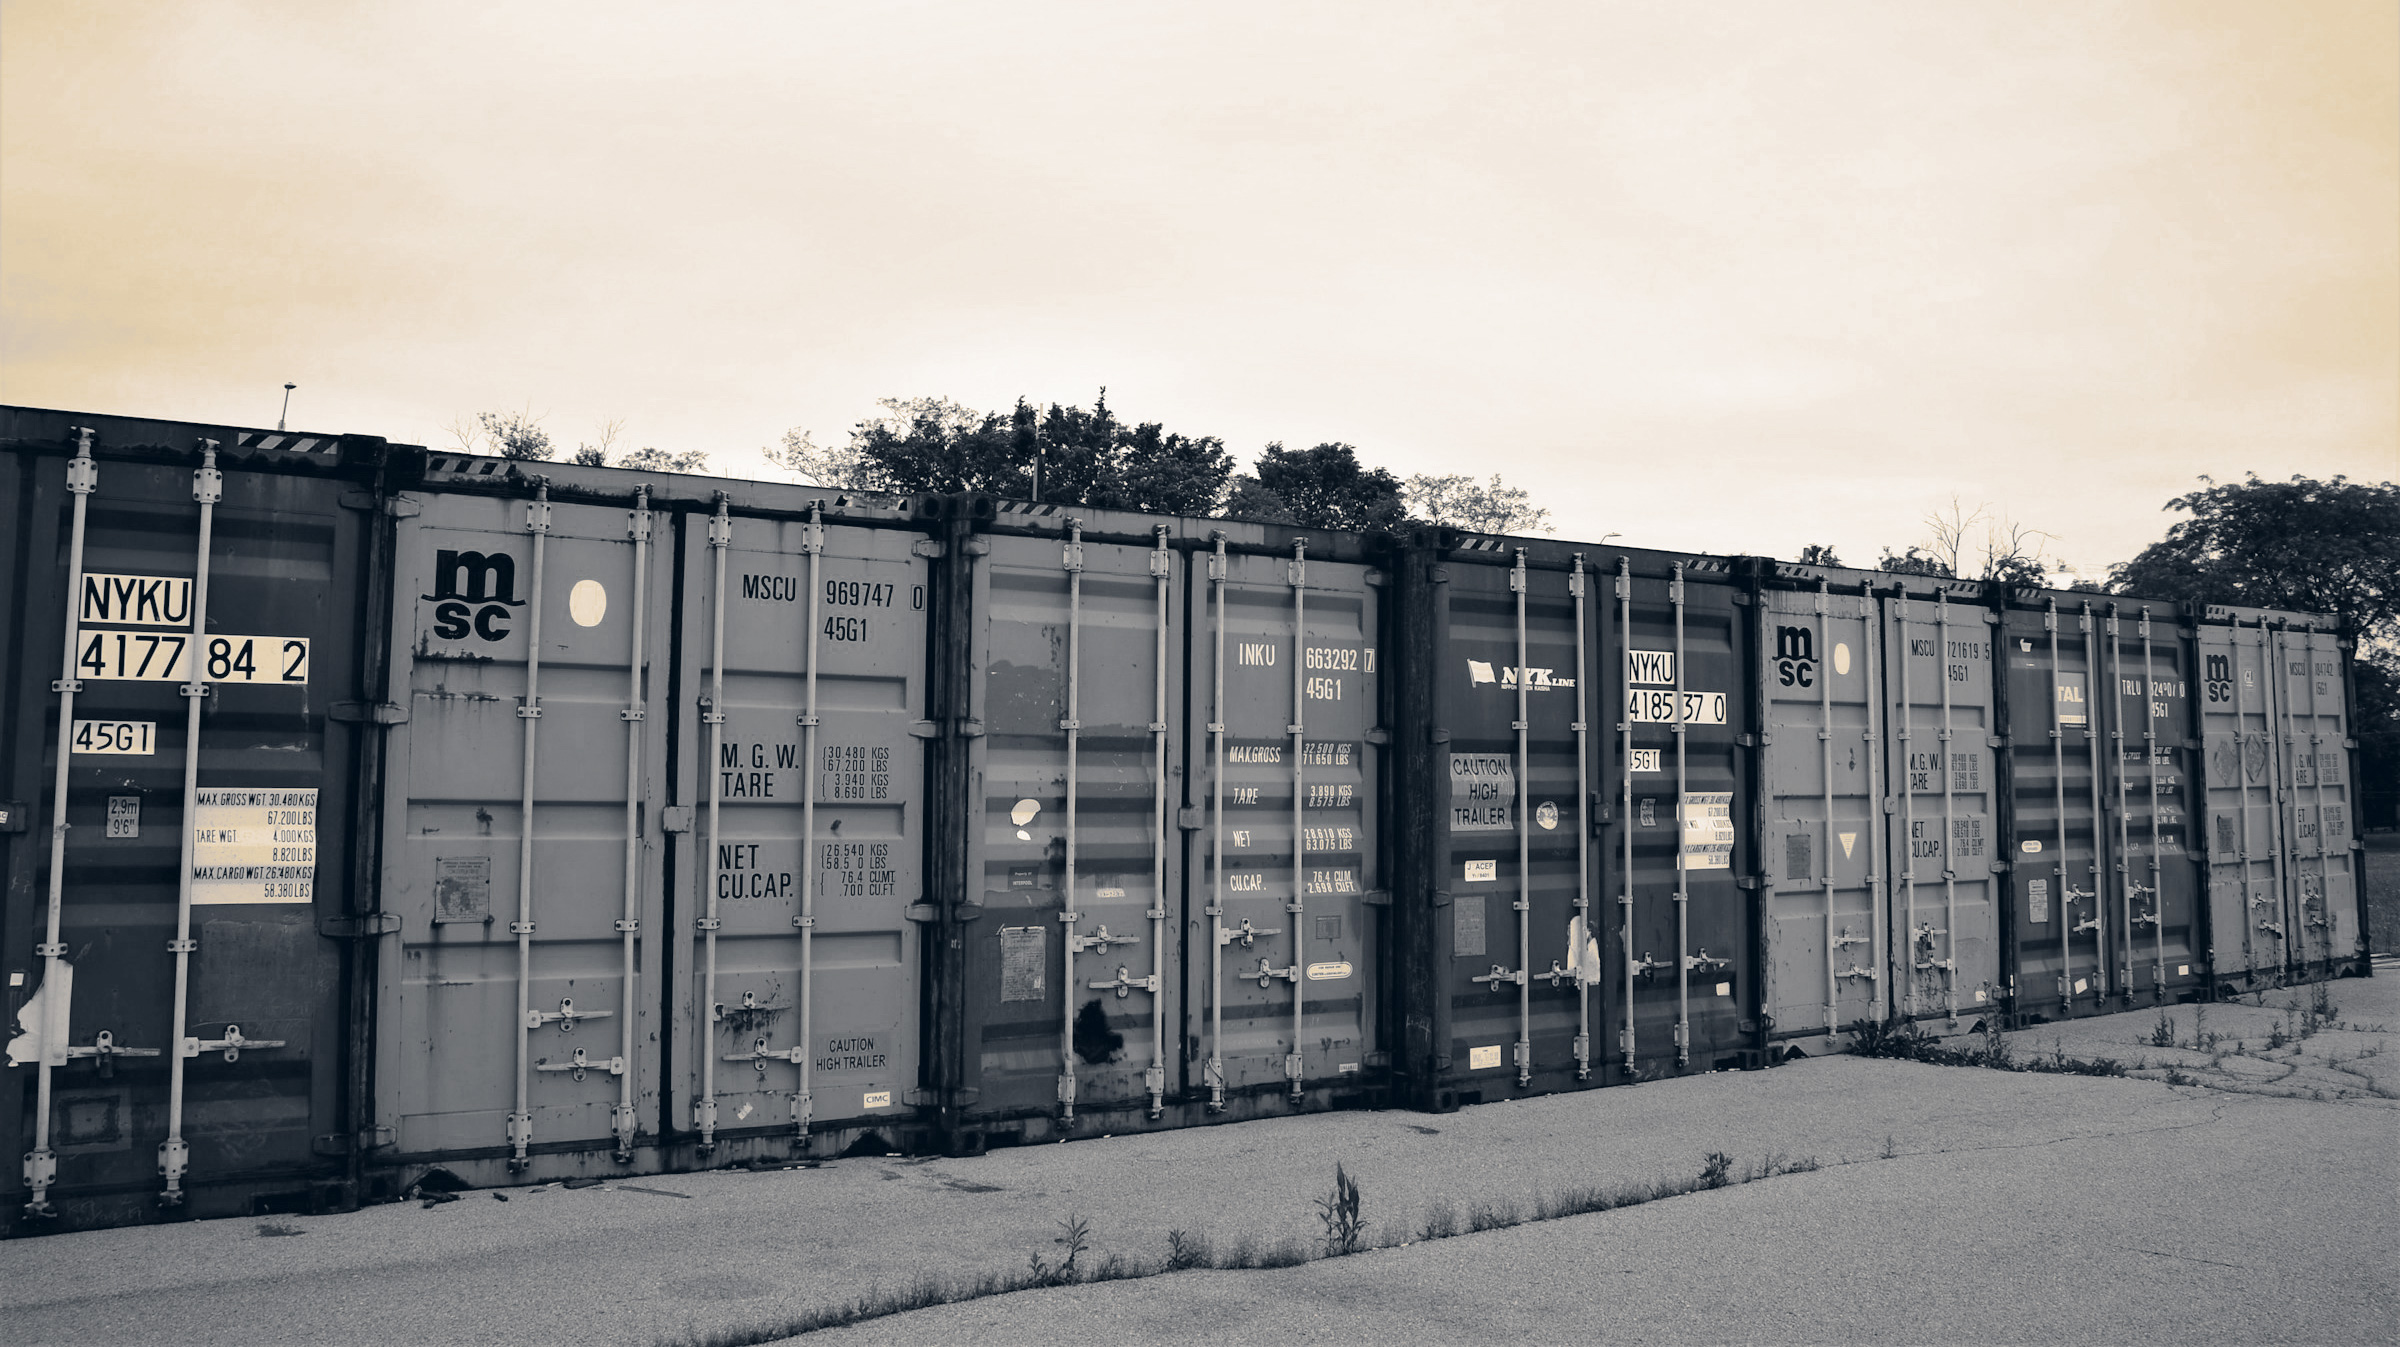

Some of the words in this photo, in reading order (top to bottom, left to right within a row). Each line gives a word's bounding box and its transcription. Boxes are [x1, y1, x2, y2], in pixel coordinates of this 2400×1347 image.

[83, 576, 190, 622] NYKU
[743, 574, 797, 602] MSCU
[826, 580, 894, 608] 969747
[911, 585, 925, 611] 0
[824, 616, 868, 642] 45G1
[1239, 643, 1275, 666] INKU
[1306, 648, 1358, 671] 663292
[1365, 649, 1374, 672] 7
[1911, 639, 1935, 657] MSCU
[1947, 641, 1979, 659] 721619
[1984, 643, 1990, 660] 5
[282, 640, 306, 682] 2
[1629, 652, 1674, 682] NYKU
[1501, 666, 1554, 686] NYK
[1552, 678, 1576, 687] LINE
[1306, 678, 1342, 700] 45G1
[2122, 679, 2141, 695] TRLU
[1714, 694, 1725, 722] 0
[76, 723, 148, 751] 45G1
[828, 746, 865, 759] 30.480
[871, 747, 889, 760] KGS
[1303, 743, 1334, 754] 32.500
[1337, 743, 1352, 754] KGS
[828, 759, 865, 772] 67.200
[871, 760, 888, 772] LBS
[1303, 754, 1332, 765] 71.650
[1335, 754, 1349, 765] LBS
[1453, 759, 1508, 776] CAUTION
[1630, 751, 1658, 770] 5G1
[721, 773, 774, 797] TARE
[834, 773, 865, 786] 3.940
[871, 774, 889, 786] KGS
[2295, 770, 2308, 784] ARE
[834, 787, 865, 799] 8.690
[871, 787, 888, 799] LBS
[1233, 788, 1259, 805] TARE
[1310, 785, 1335, 797] 3.890
[1338, 785, 1352, 796] KGS
[1468, 783, 1498, 800] HIGH
[1309, 797, 1334, 807] 8.575
[1336, 797, 1351, 807] LBS
[1455, 808, 1506, 826] TRAILER
[196, 829, 216, 843] TARE
[1233, 831, 1251, 847] NET
[1304, 828, 1335, 839] 28.610
[1338, 828, 1352, 839] KGS
[826, 844, 864, 857] 26.540
[870, 844, 888, 857] KGS
[1306, 839, 1336, 851] 63.075
[1339, 839, 1352, 850] LBS
[719, 844, 760, 870] NET
[870, 857, 887, 869] LBS
[1476, 862, 1493, 870] ACEP
[841, 871, 863, 883] 76.4
[1313, 871, 1330, 882] 76.4
[718, 873, 794, 899] CU.CAP.
[1307, 882, 1333, 893] 2.698
[829, 1037, 874, 1053] CAUTION
[816, 1058, 840, 1071] HIGH
[843, 1054, 886, 1070] TRAILER
[866, 1094, 889, 1103] CIMC
